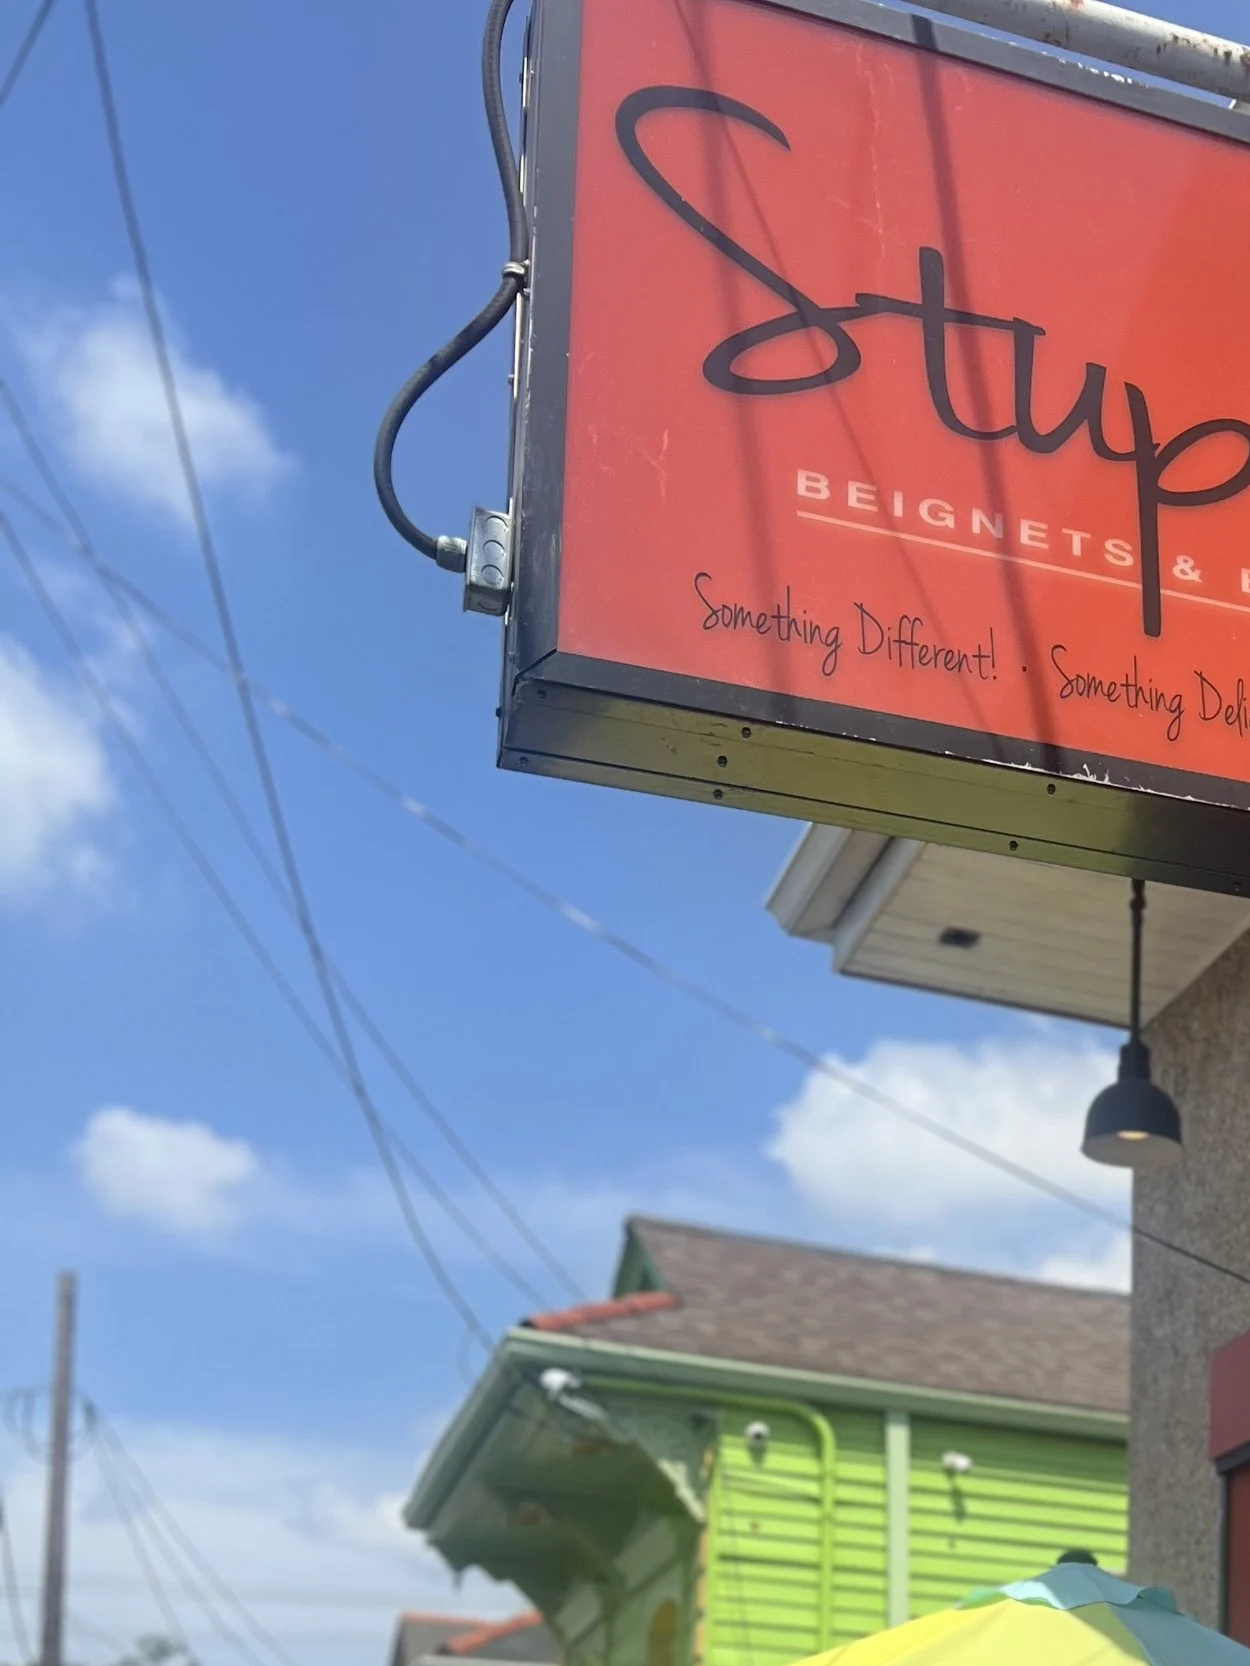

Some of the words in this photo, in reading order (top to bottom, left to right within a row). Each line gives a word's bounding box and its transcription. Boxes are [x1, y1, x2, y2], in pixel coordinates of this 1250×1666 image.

[796, 468, 1135, 568] BEIGNETS
[1172, 554, 1204, 583] &
[694, 572, 841, 676] Something
[854, 601, 999, 680] Different!
[1050, 644, 1185, 741] Something
